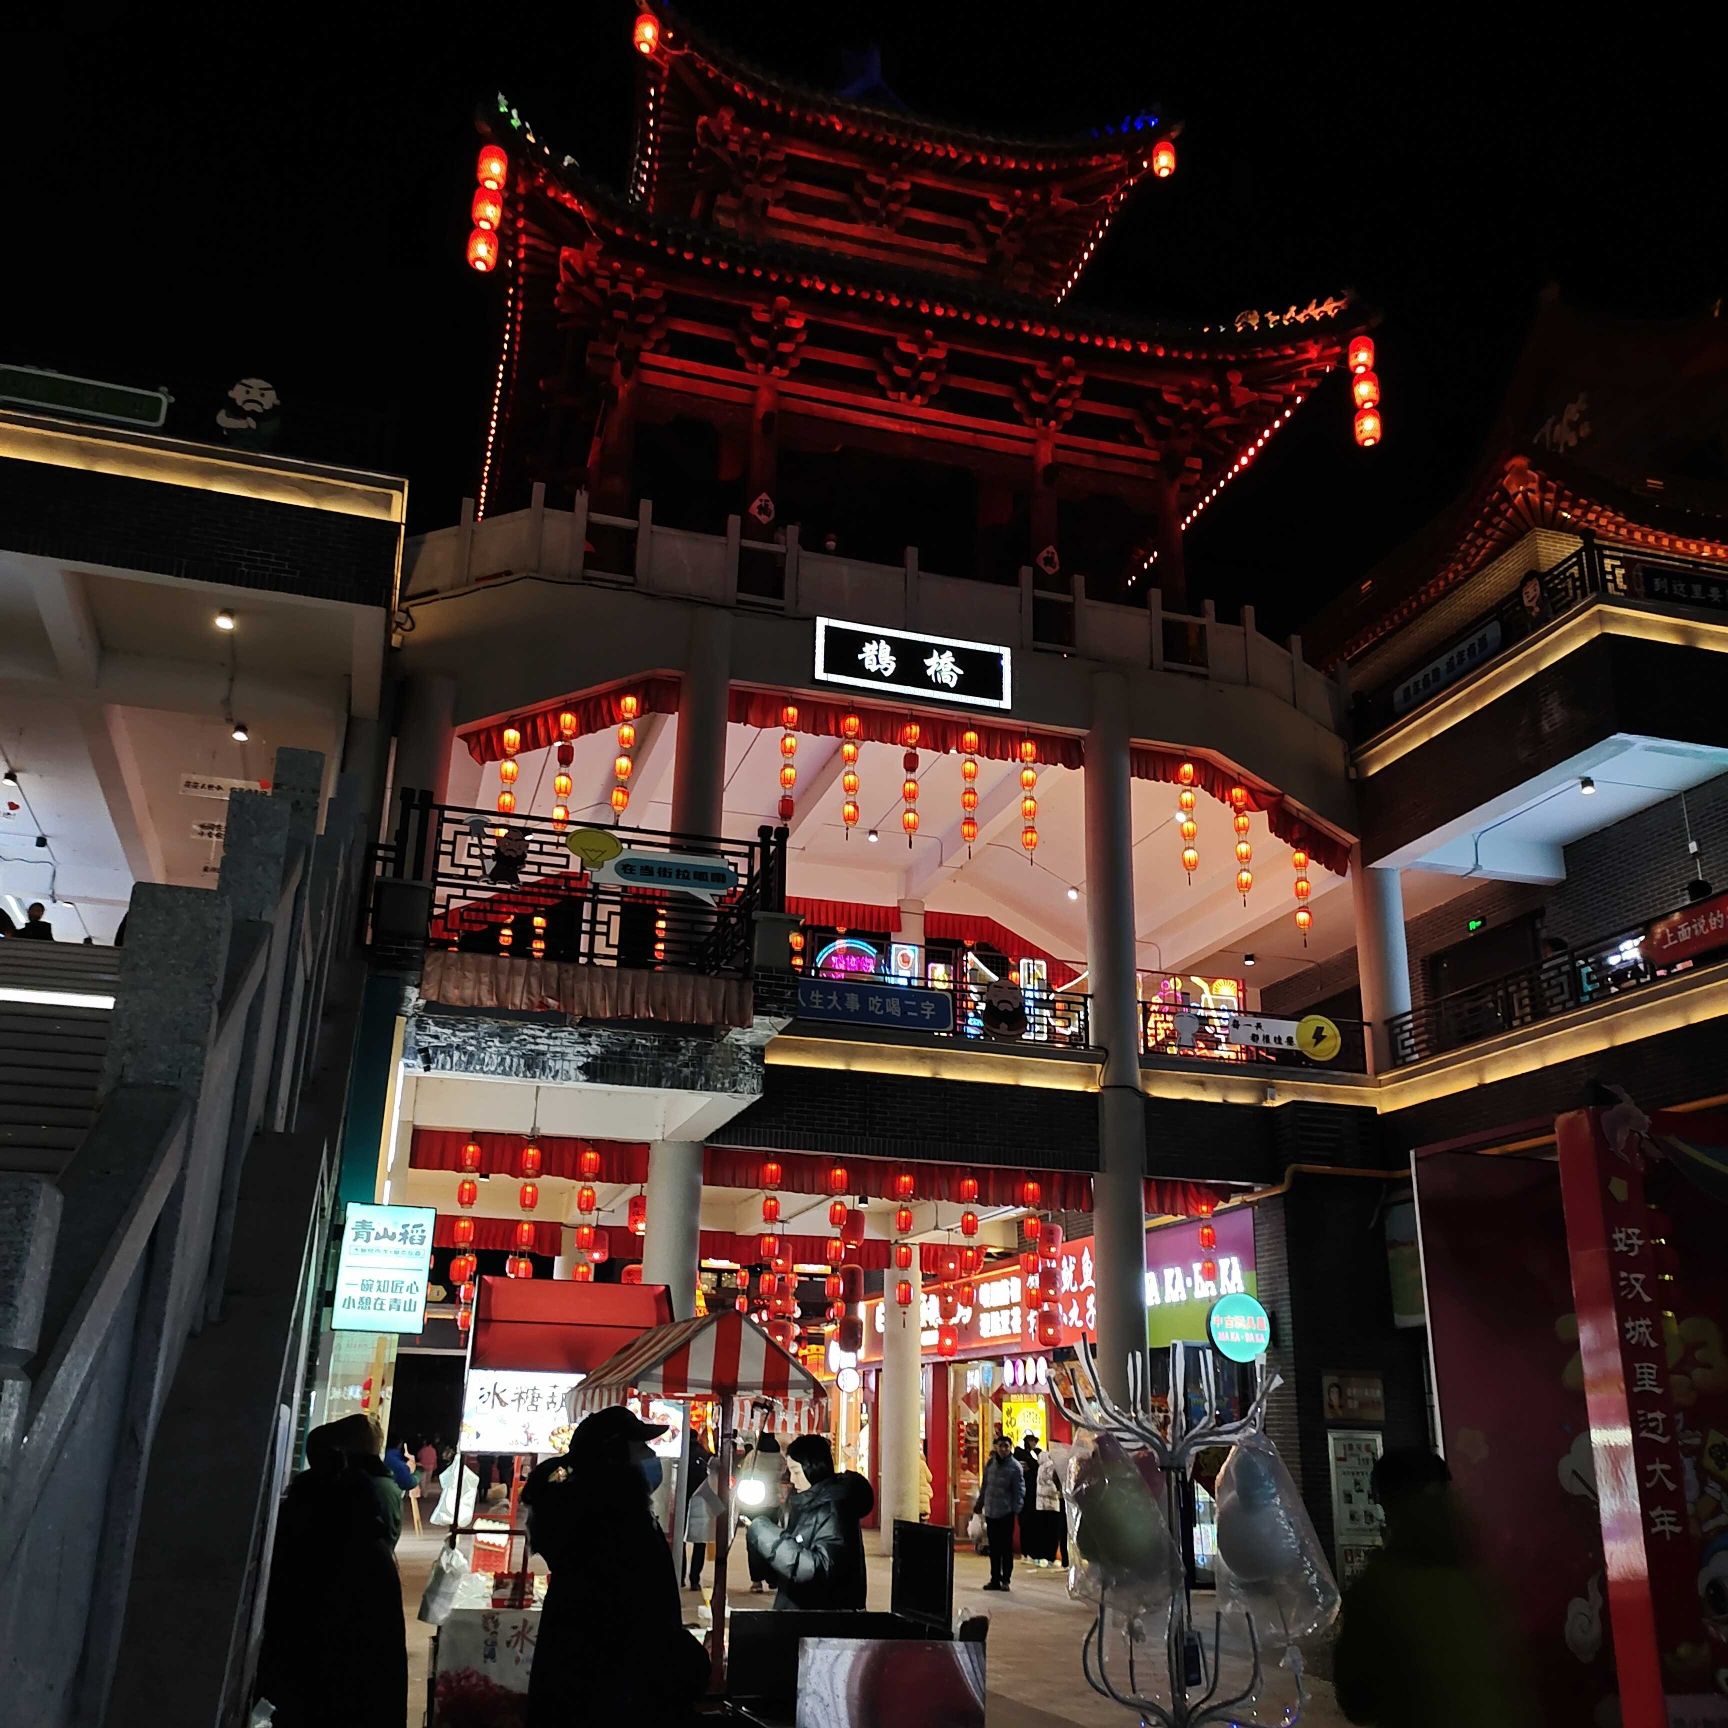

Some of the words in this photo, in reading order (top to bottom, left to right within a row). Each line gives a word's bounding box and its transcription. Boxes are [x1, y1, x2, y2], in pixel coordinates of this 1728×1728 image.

[1662, 907, 1728, 949] 上面说的
[868, 996, 936, 1020] 吃喝二字
[351, 1220, 427, 1246] 青山稻
[345, 1279, 420, 1295] 一碗知匠心
[342, 1296, 417, 1312] 小憩在青山
[1612, 1225, 1683, 1541] 好汉城里过大年
